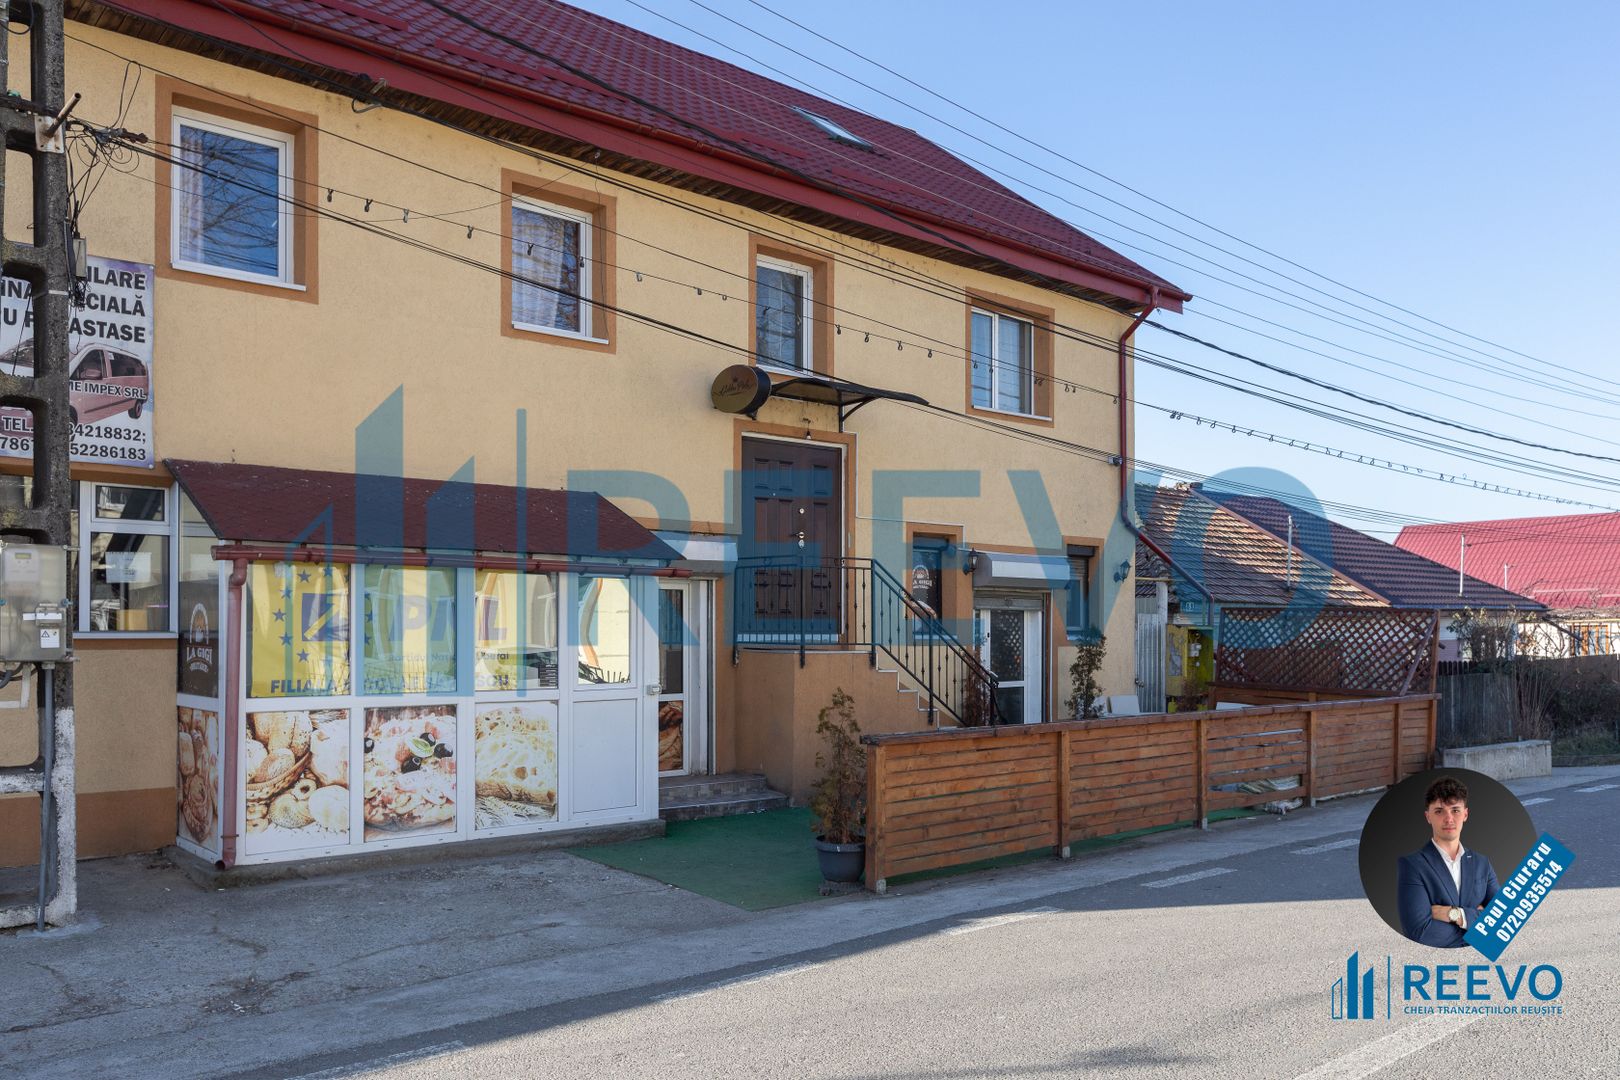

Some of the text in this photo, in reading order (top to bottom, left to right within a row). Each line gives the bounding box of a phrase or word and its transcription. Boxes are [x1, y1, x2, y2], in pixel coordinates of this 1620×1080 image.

[87, 265, 146, 291] ILARE
[86, 292, 146, 317] CIALĂ
[84, 382, 122, 397] IMPEX
[124, 387, 146, 399] SRL
[69, 421, 147, 445] 4218832;
[70, 443, 147, 461] 52286183
